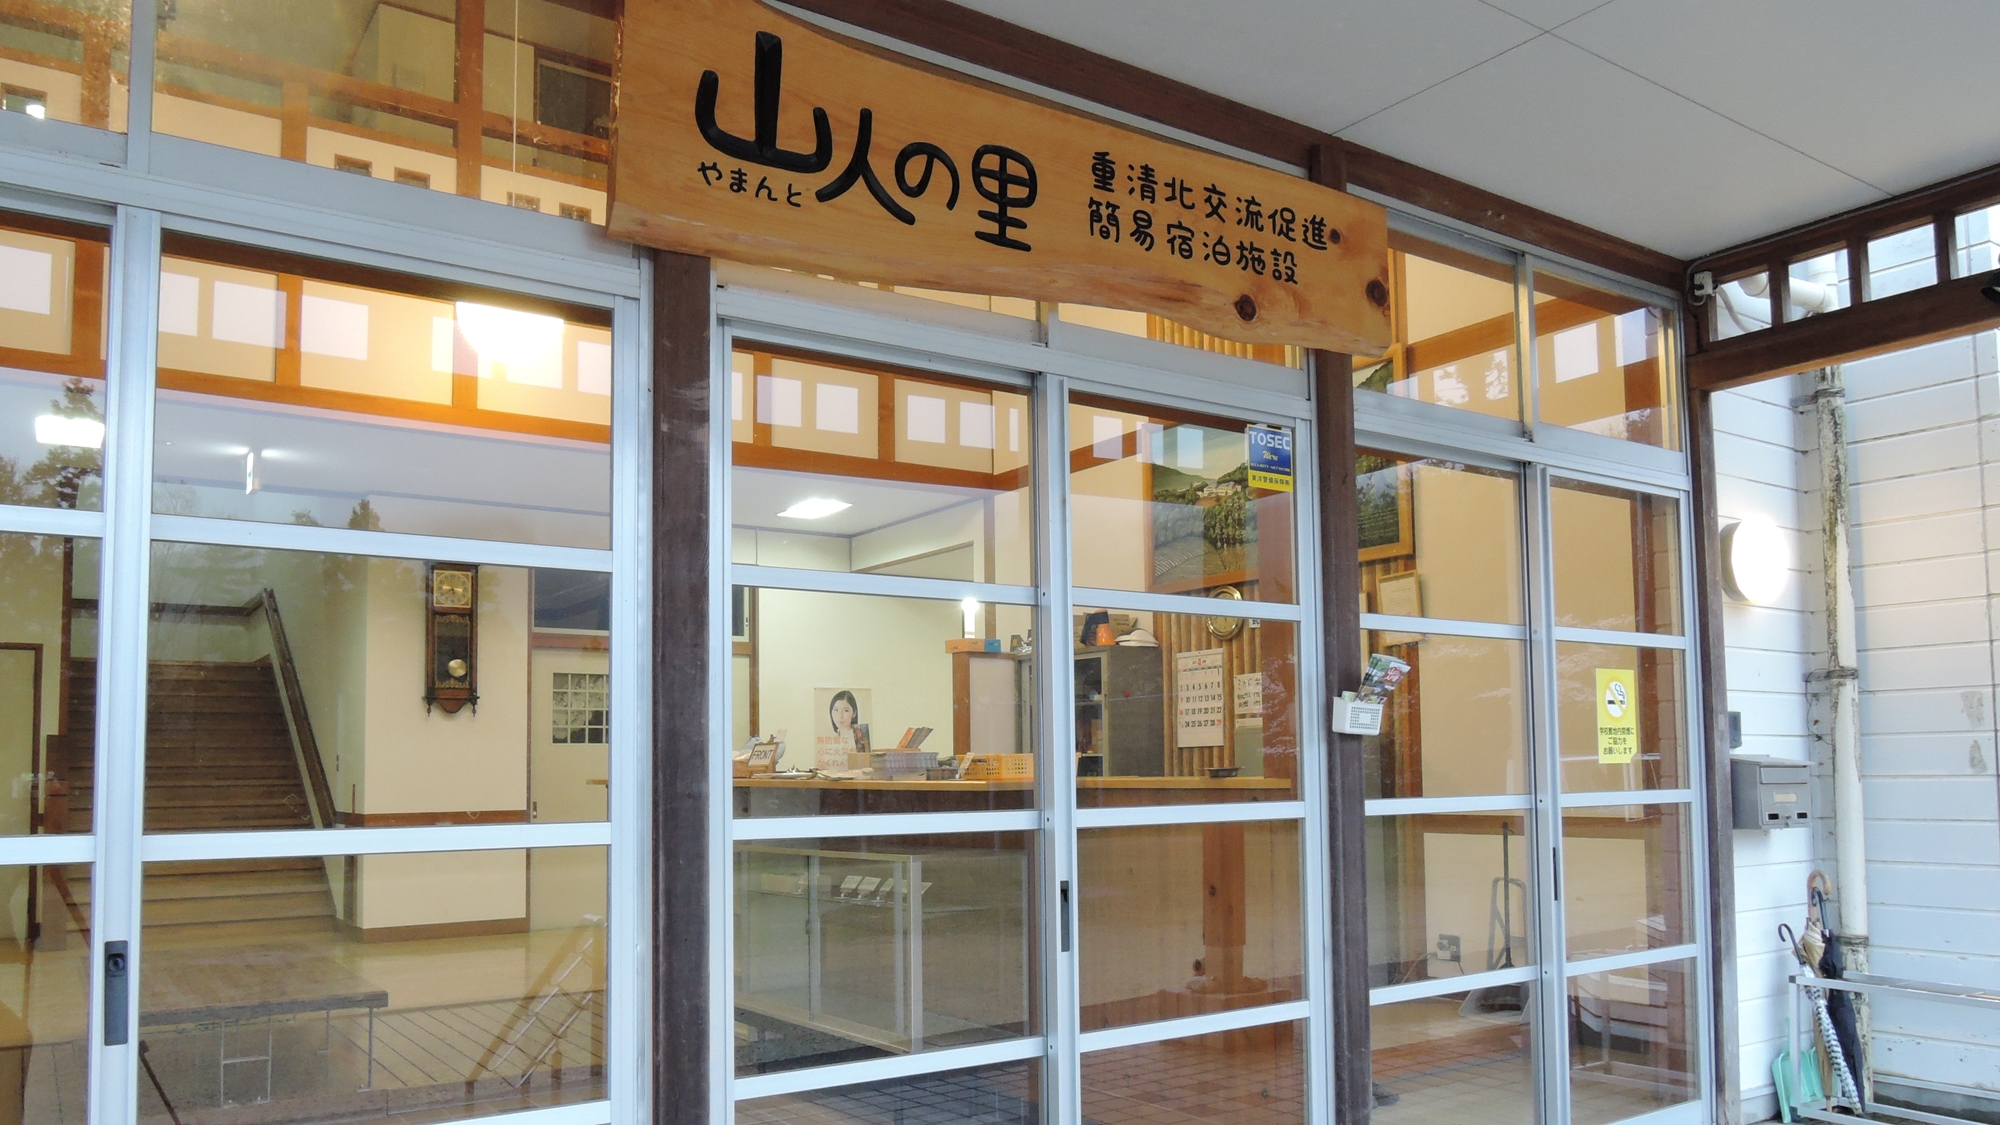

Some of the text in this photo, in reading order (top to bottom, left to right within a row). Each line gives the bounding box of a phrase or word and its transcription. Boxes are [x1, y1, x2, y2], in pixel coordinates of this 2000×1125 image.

[694, 31, 1038, 252] 山人の里
[696, 161, 803, 208] やまんと
[1091, 151, 1328, 250] 重清北交流促進
[1087, 196, 1299, 285] 簡易宿泊施設
[1249, 431, 1290, 450] TOSEC
[752, 750, 774, 760] FRONT
[1608, 737, 1627, 745] ご協力を
